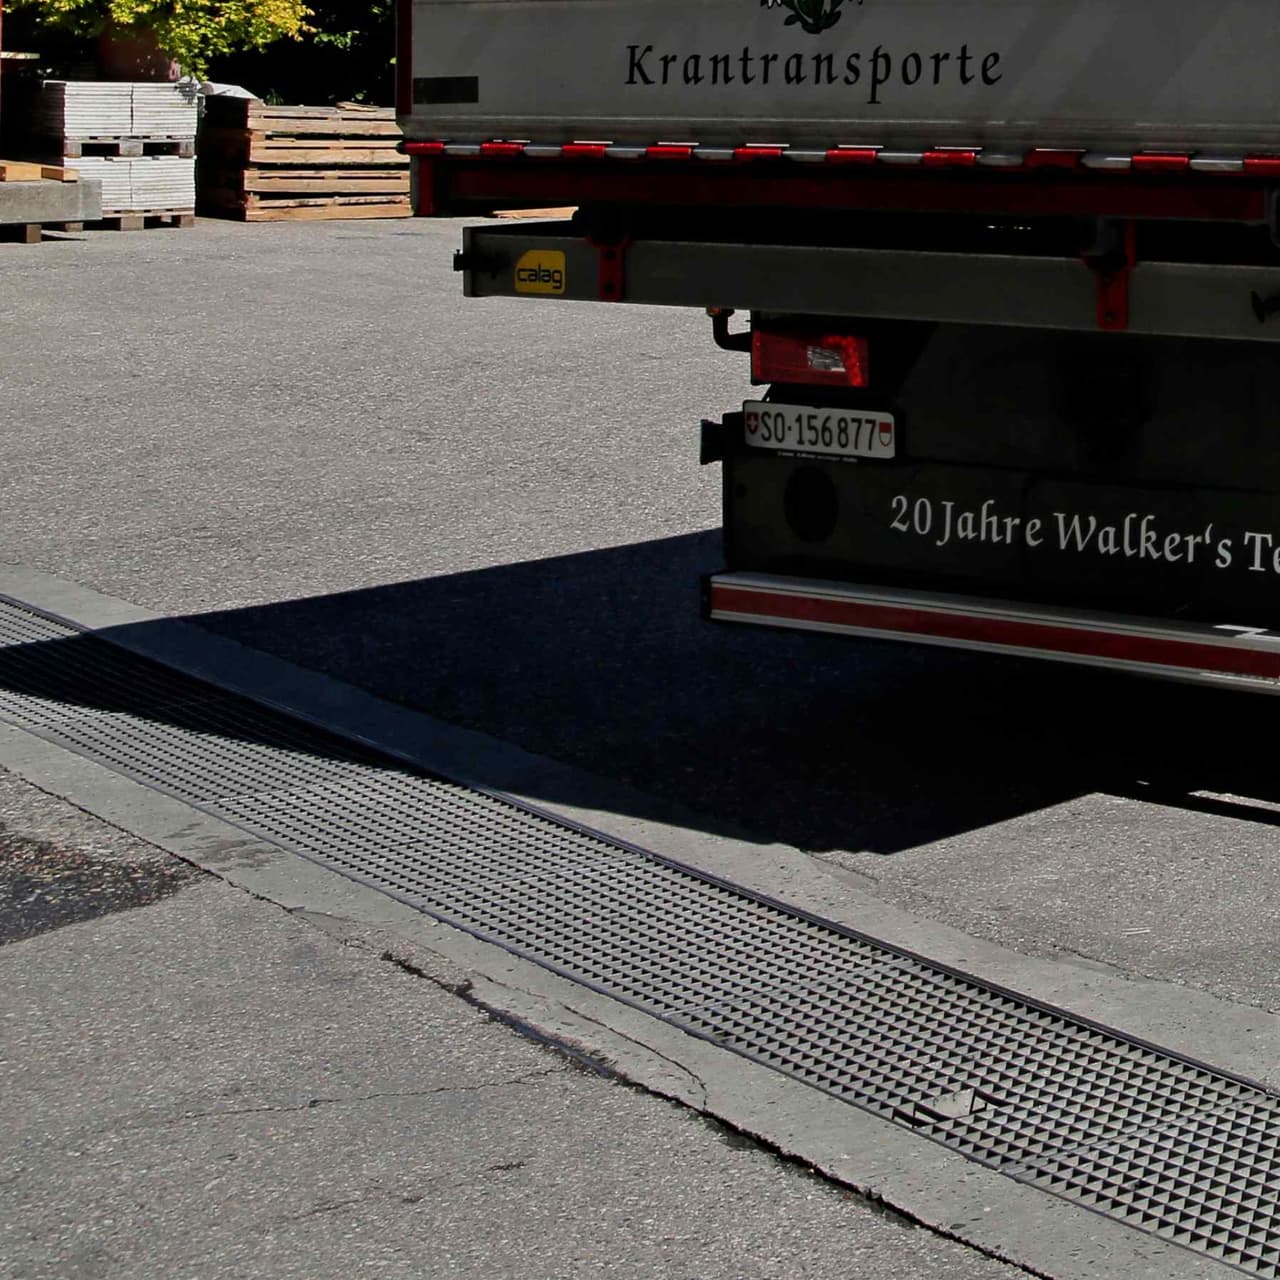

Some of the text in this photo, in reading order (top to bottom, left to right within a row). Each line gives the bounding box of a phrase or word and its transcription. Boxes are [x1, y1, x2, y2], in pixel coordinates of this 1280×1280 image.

[624, 44, 1003, 105] Krantransporte
[517, 263, 563, 289] calag
[889, 495, 932, 535] 20
[936, 499, 1043, 546] Jahre
[1053, 512, 1233, 568] Walker's
